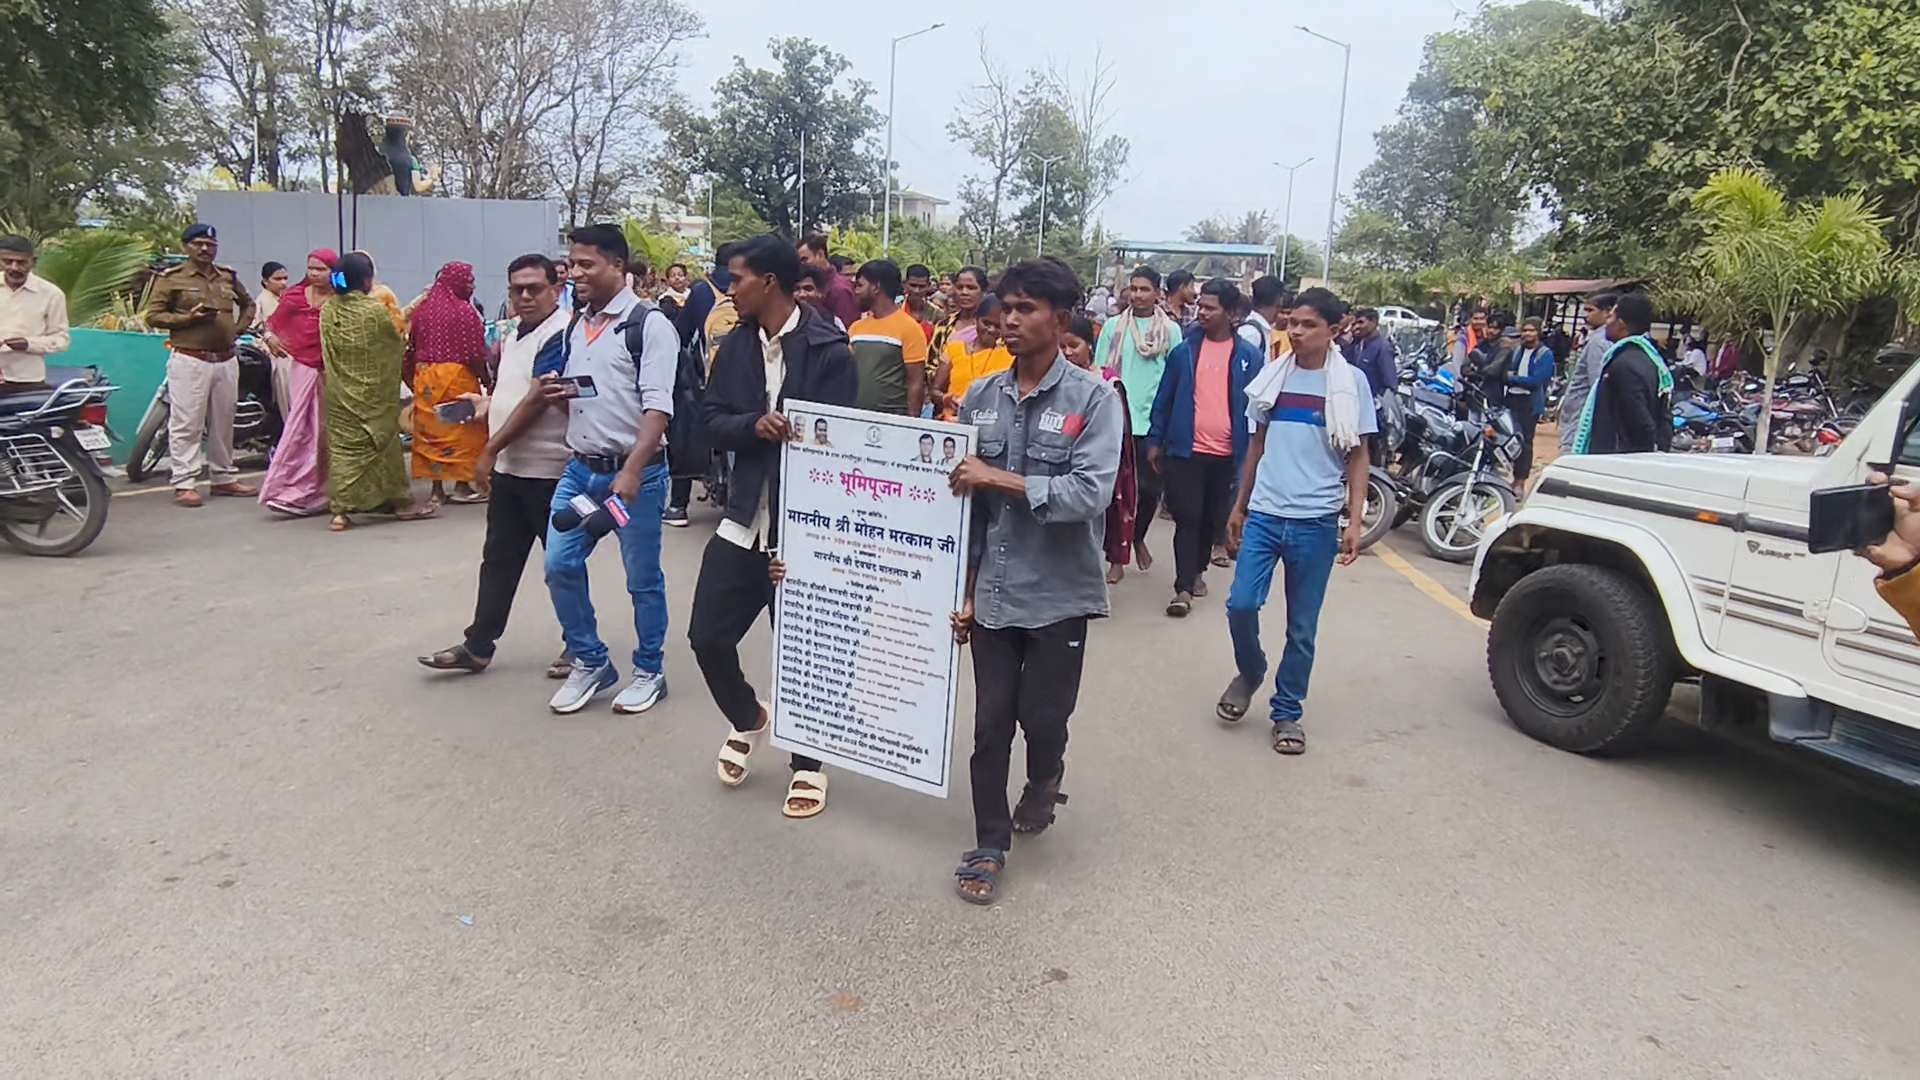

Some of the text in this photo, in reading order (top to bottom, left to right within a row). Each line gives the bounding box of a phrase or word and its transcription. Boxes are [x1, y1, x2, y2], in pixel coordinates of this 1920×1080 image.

[840, 469, 902, 500] भूमिपूजन
[788, 510, 955, 553] माननीय श्री मोहन मरकाम जी
[814, 552, 840, 563] माननीय
[843, 555, 852, 566] श्री
[911, 570, 921, 580] जी
